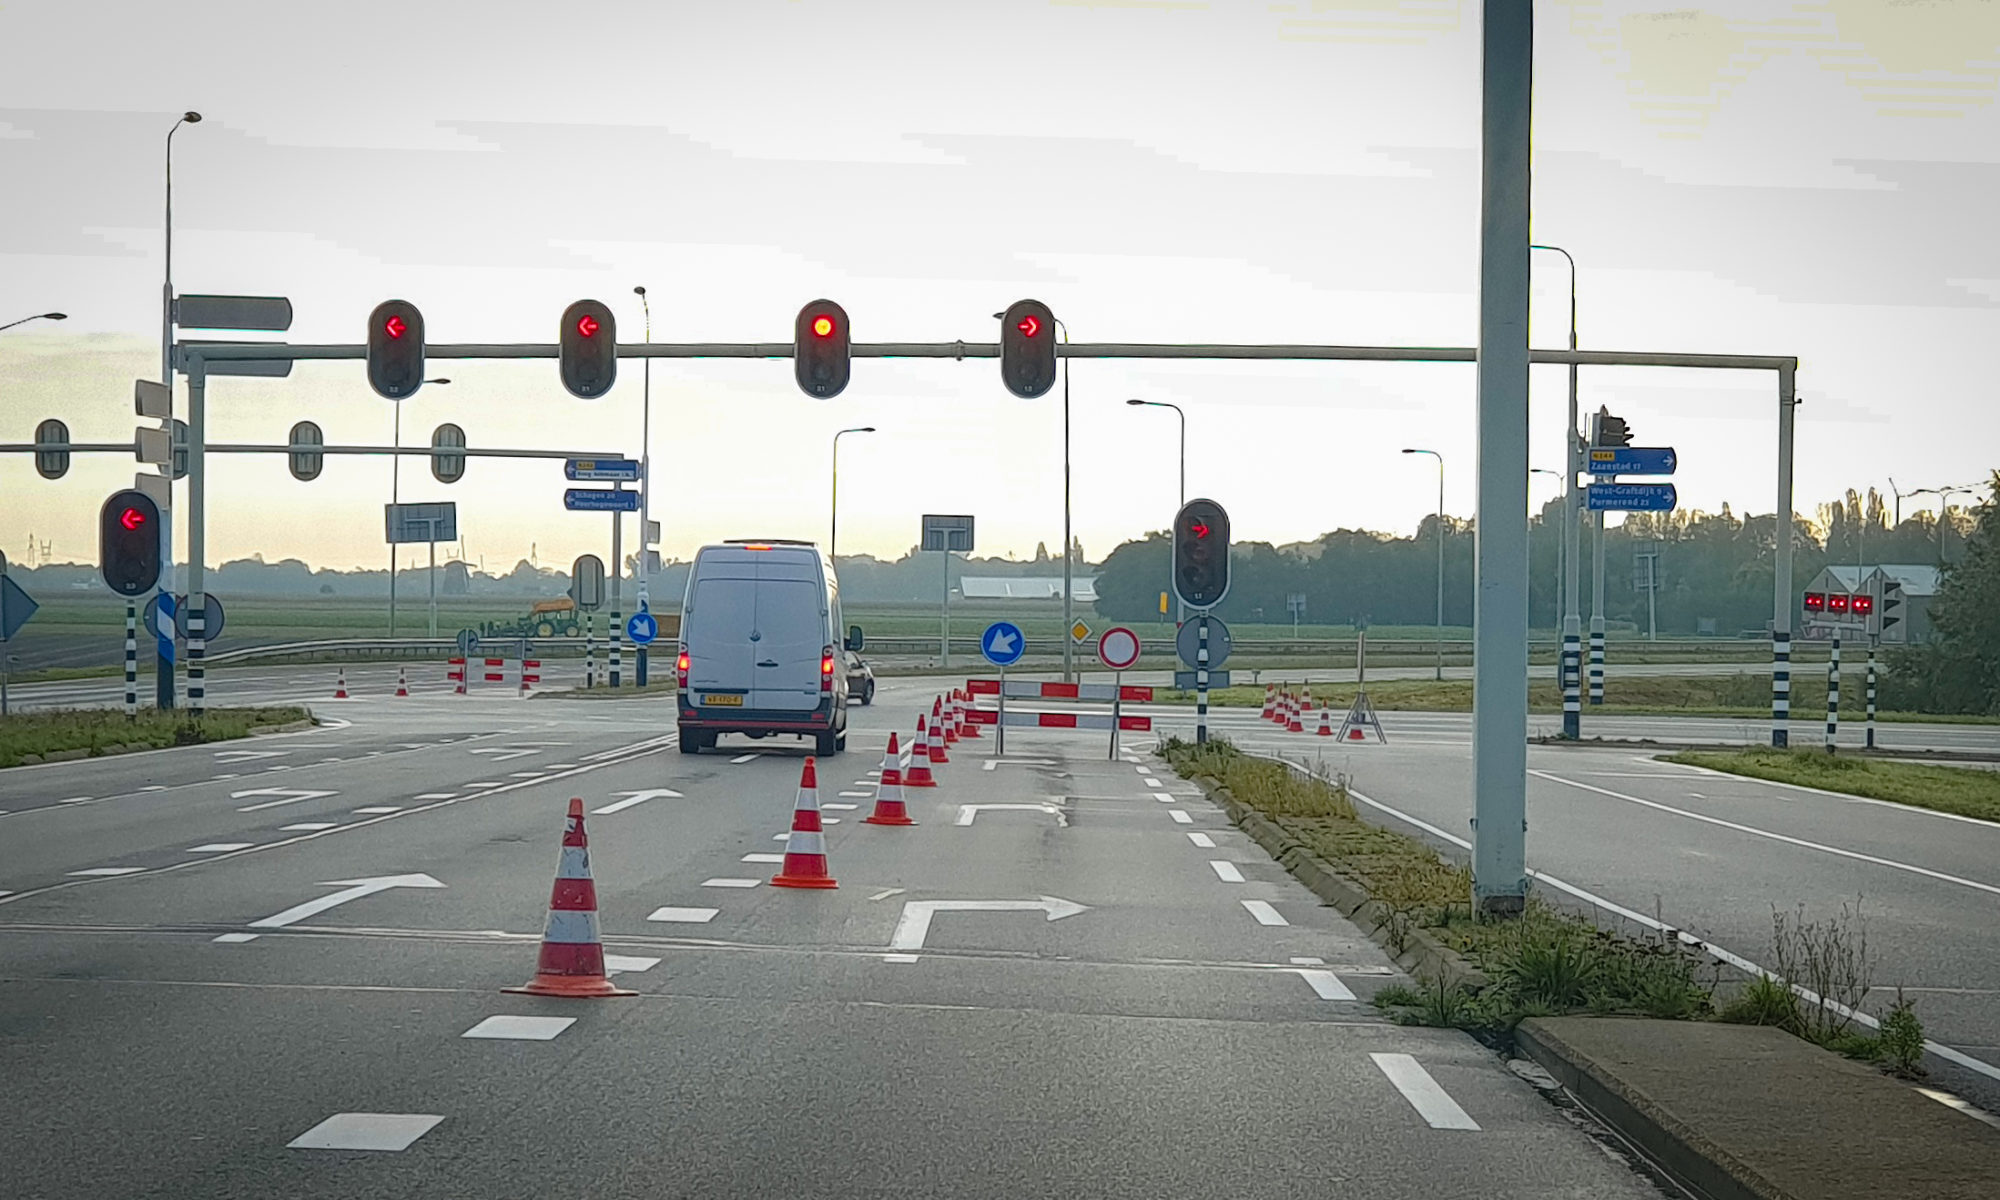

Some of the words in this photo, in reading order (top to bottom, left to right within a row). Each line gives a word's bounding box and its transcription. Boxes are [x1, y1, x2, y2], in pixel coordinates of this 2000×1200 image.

[1591, 462, 1631, 470] Zaanstad
[575, 491, 605, 500] Schagen
[1591, 498, 1638, 506] Purmerend
